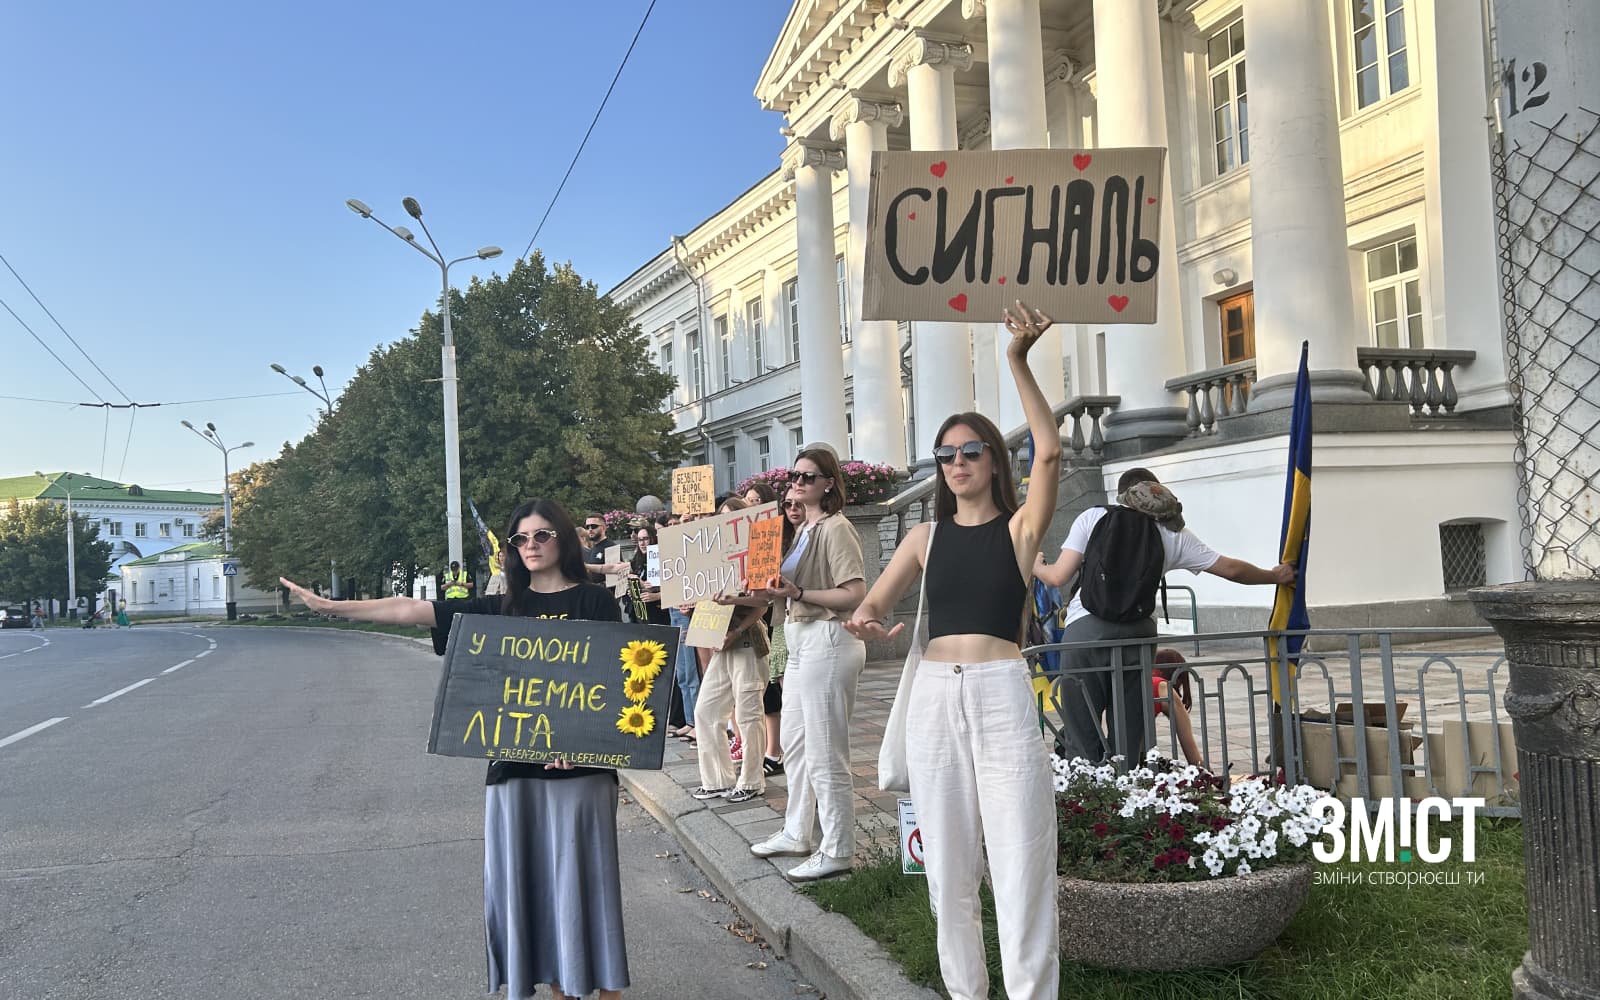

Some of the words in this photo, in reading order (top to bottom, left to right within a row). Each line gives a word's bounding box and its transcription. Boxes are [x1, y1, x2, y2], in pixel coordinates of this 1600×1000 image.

[1501, 58, 1550, 118] 12
[885, 175, 1160, 286] СИГНАЛЬ
[682, 524, 722, 558] МИ
[662, 556, 686, 581] БО
[683, 564, 736, 601] ВОНИ
[468, 632, 487, 655] У
[503, 676, 608, 712] НЕМАЄ
